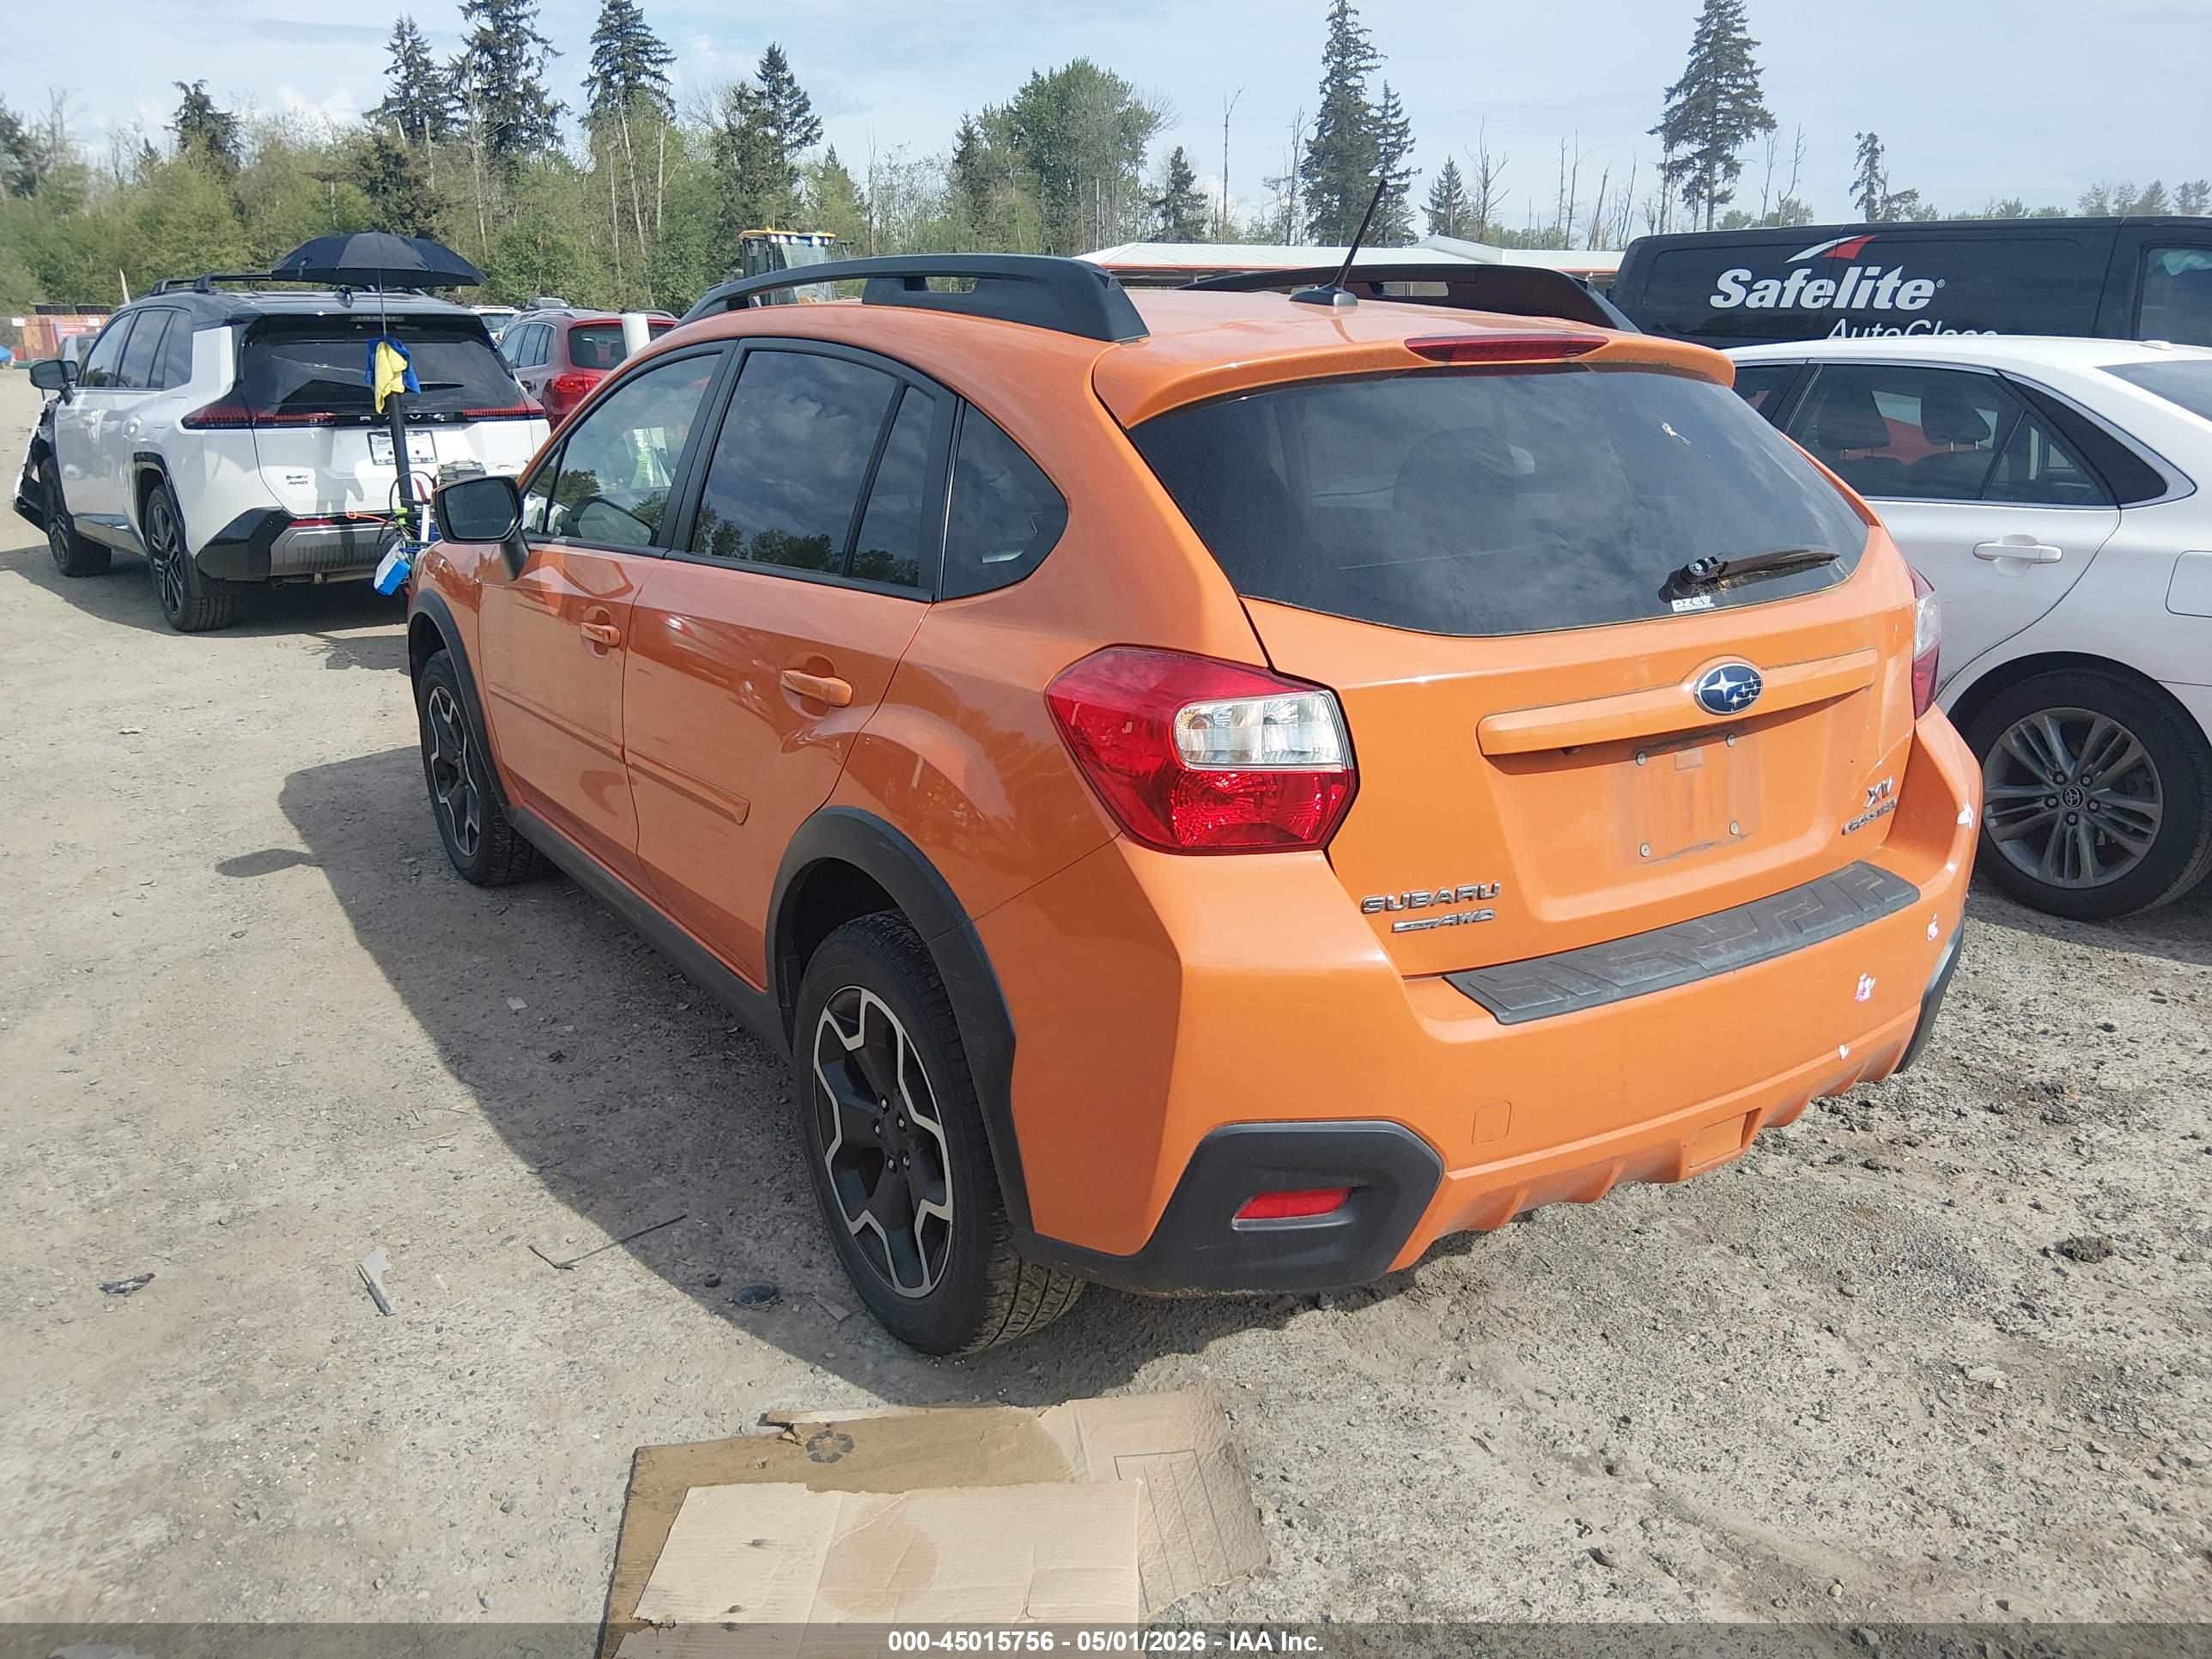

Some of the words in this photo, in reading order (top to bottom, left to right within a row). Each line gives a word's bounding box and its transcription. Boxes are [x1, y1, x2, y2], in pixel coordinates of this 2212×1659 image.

[1863, 775, 1893, 808] XV
[1361, 880, 1501, 914] SUBARU
[1432, 908, 1497, 928] AWD
